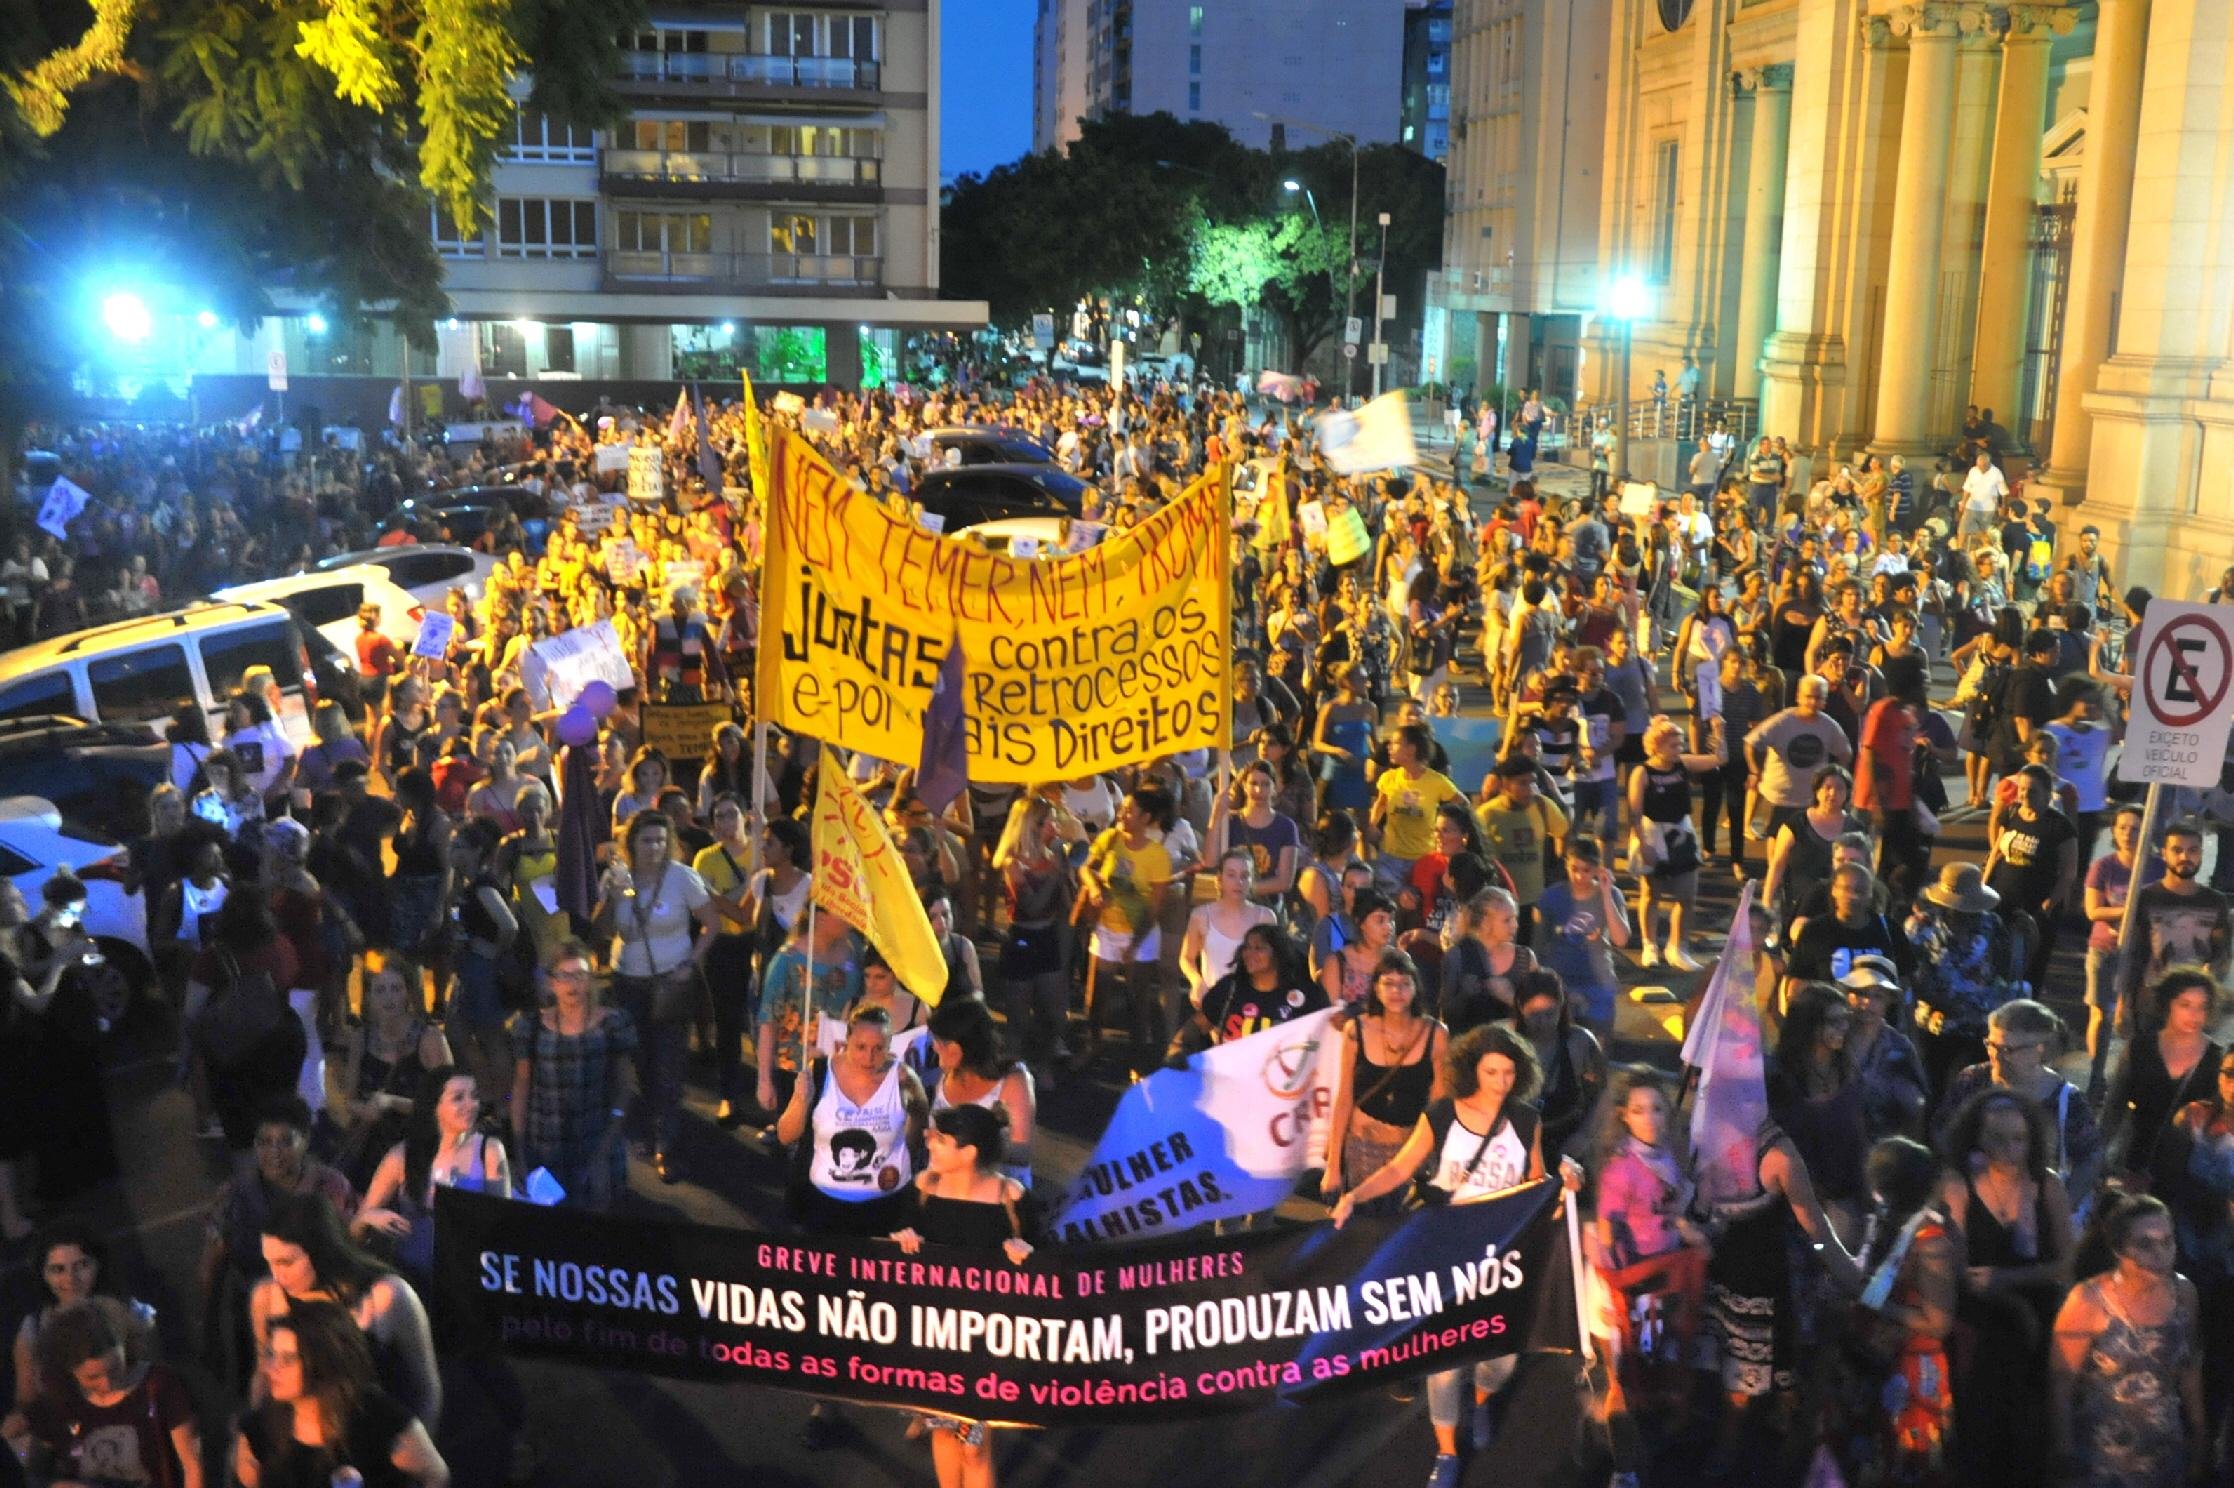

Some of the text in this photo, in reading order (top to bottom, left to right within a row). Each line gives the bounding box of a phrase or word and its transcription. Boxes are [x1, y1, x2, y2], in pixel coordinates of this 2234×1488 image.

[990, 618, 1139, 671] contra
[1153, 598, 1207, 639] os
[921, 706, 1037, 766] ais
[1048, 689, 1221, 769] Direitos
[479, 1243, 1524, 1365] SE NOSSAS VIDAS NÃO IMPORTAM, PRODUZAM SEM NÓS
[757, 1243, 1244, 1300] GREVE INTERNACIONAL DE MULHERES
[701, 1338, 791, 1371] todas
[800, 1353, 838, 1378] as
[848, 1356, 966, 1395] formas
[975, 1371, 1021, 1402] de
[1029, 1372, 1188, 1407] violência
[1196, 1359, 1302, 1396] contra
[1312, 1354, 1351, 1380] as
[1360, 1313, 1507, 1371] mulheres
